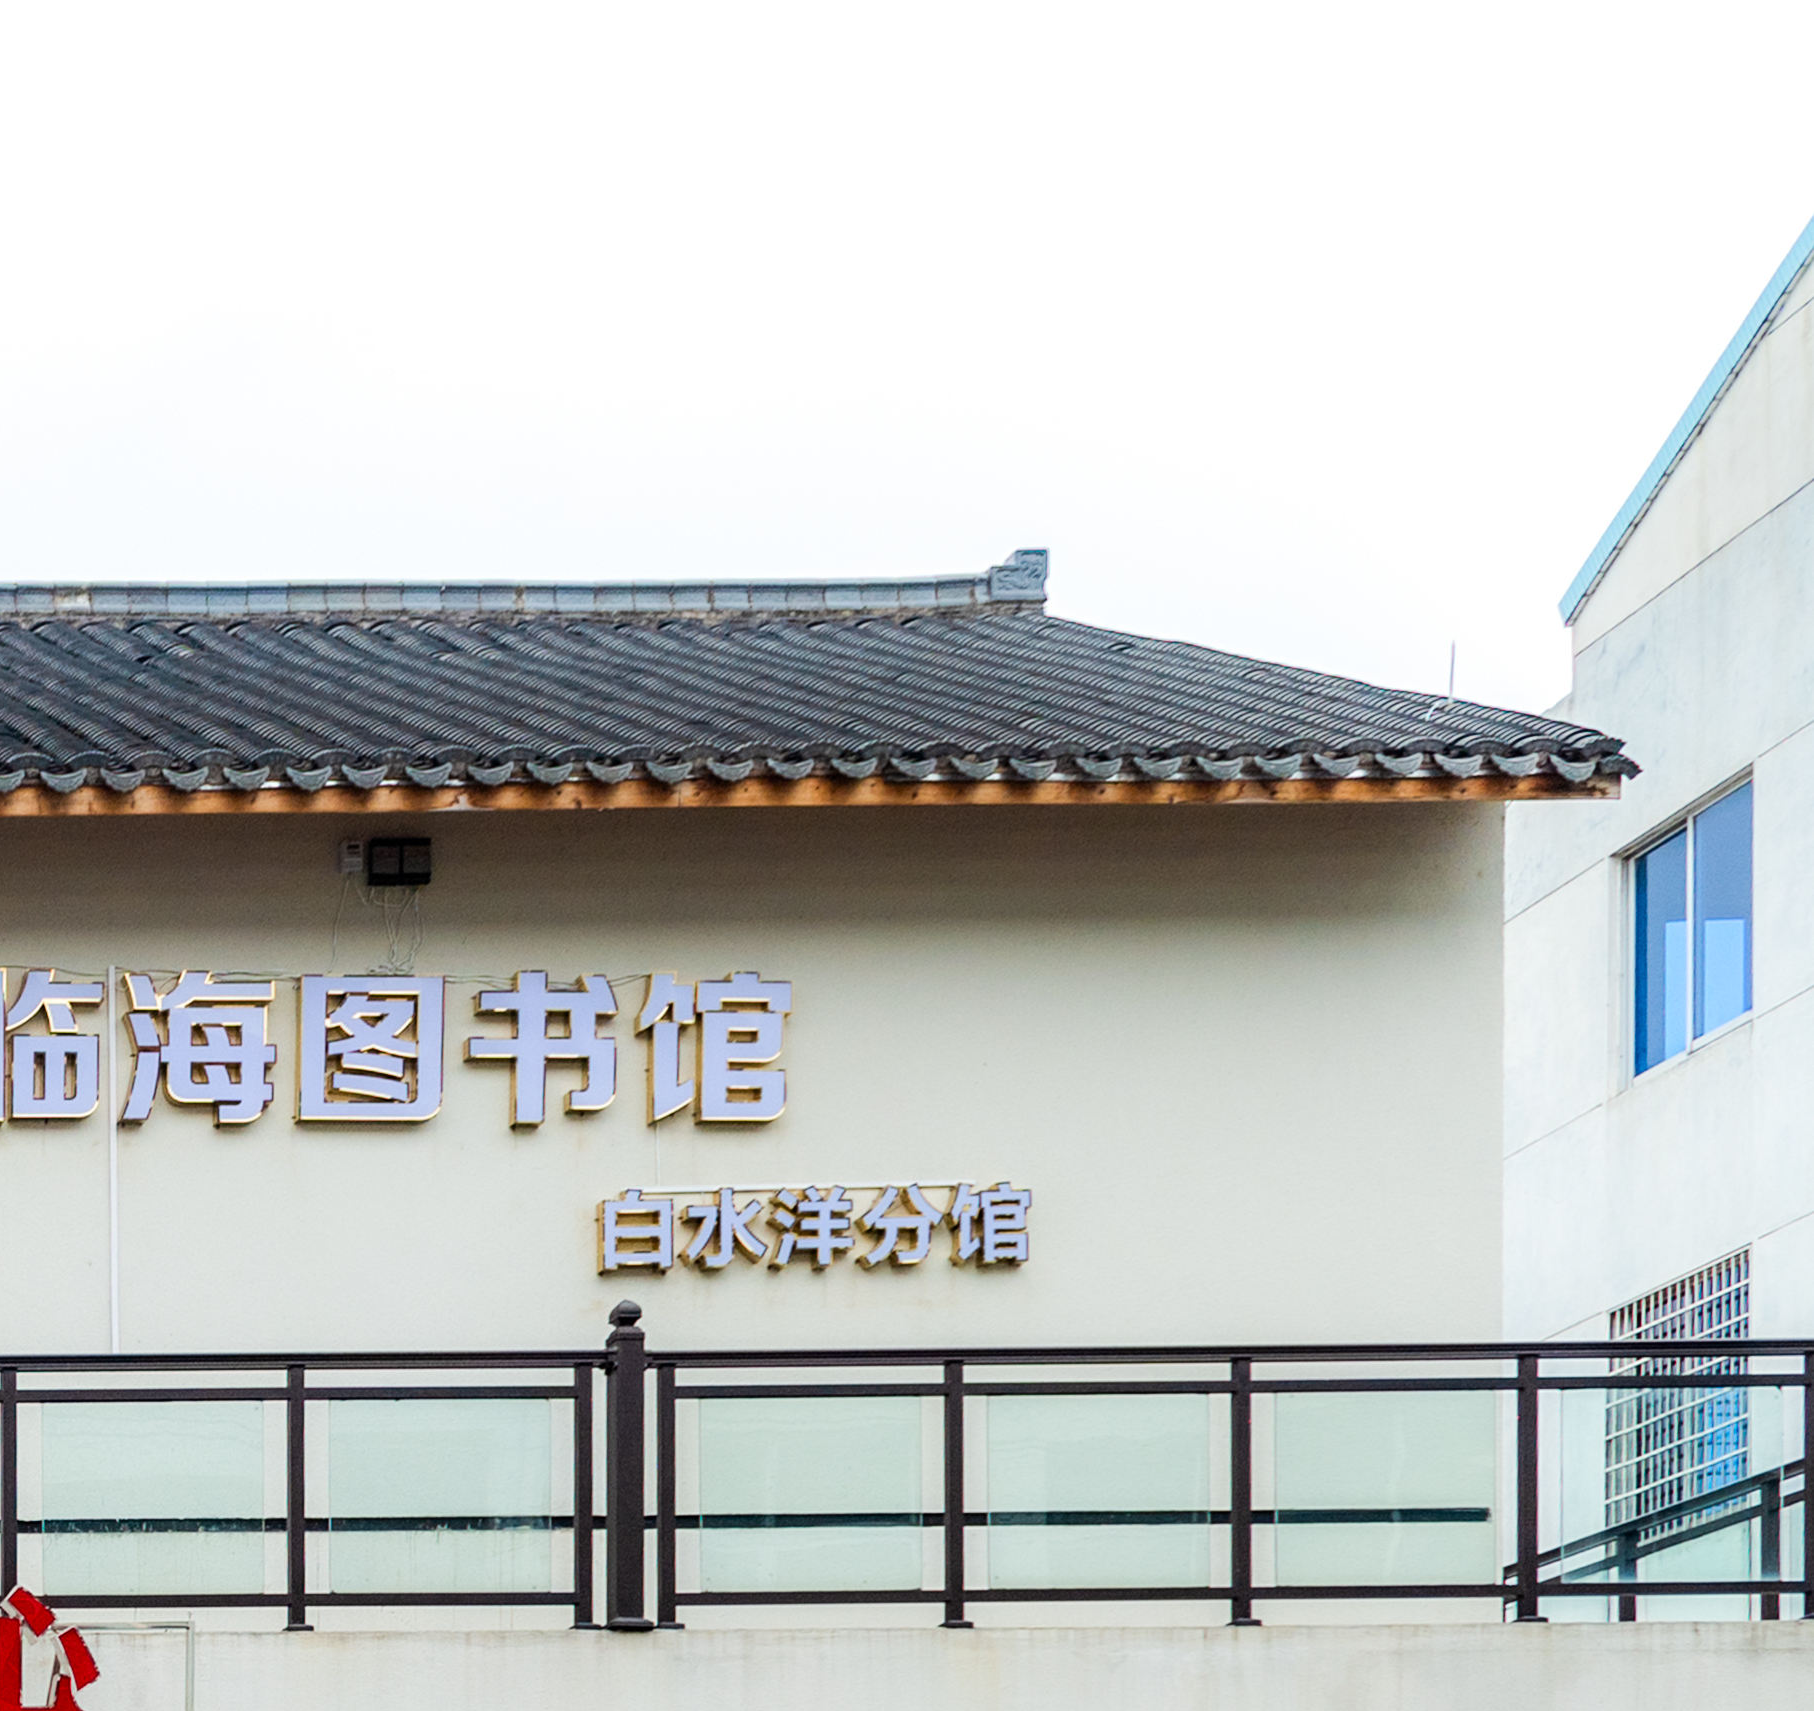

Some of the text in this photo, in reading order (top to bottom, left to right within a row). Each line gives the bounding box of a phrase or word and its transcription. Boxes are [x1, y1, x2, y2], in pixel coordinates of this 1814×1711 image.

[598, 1182, 1032, 1275] 白水洋分馆
